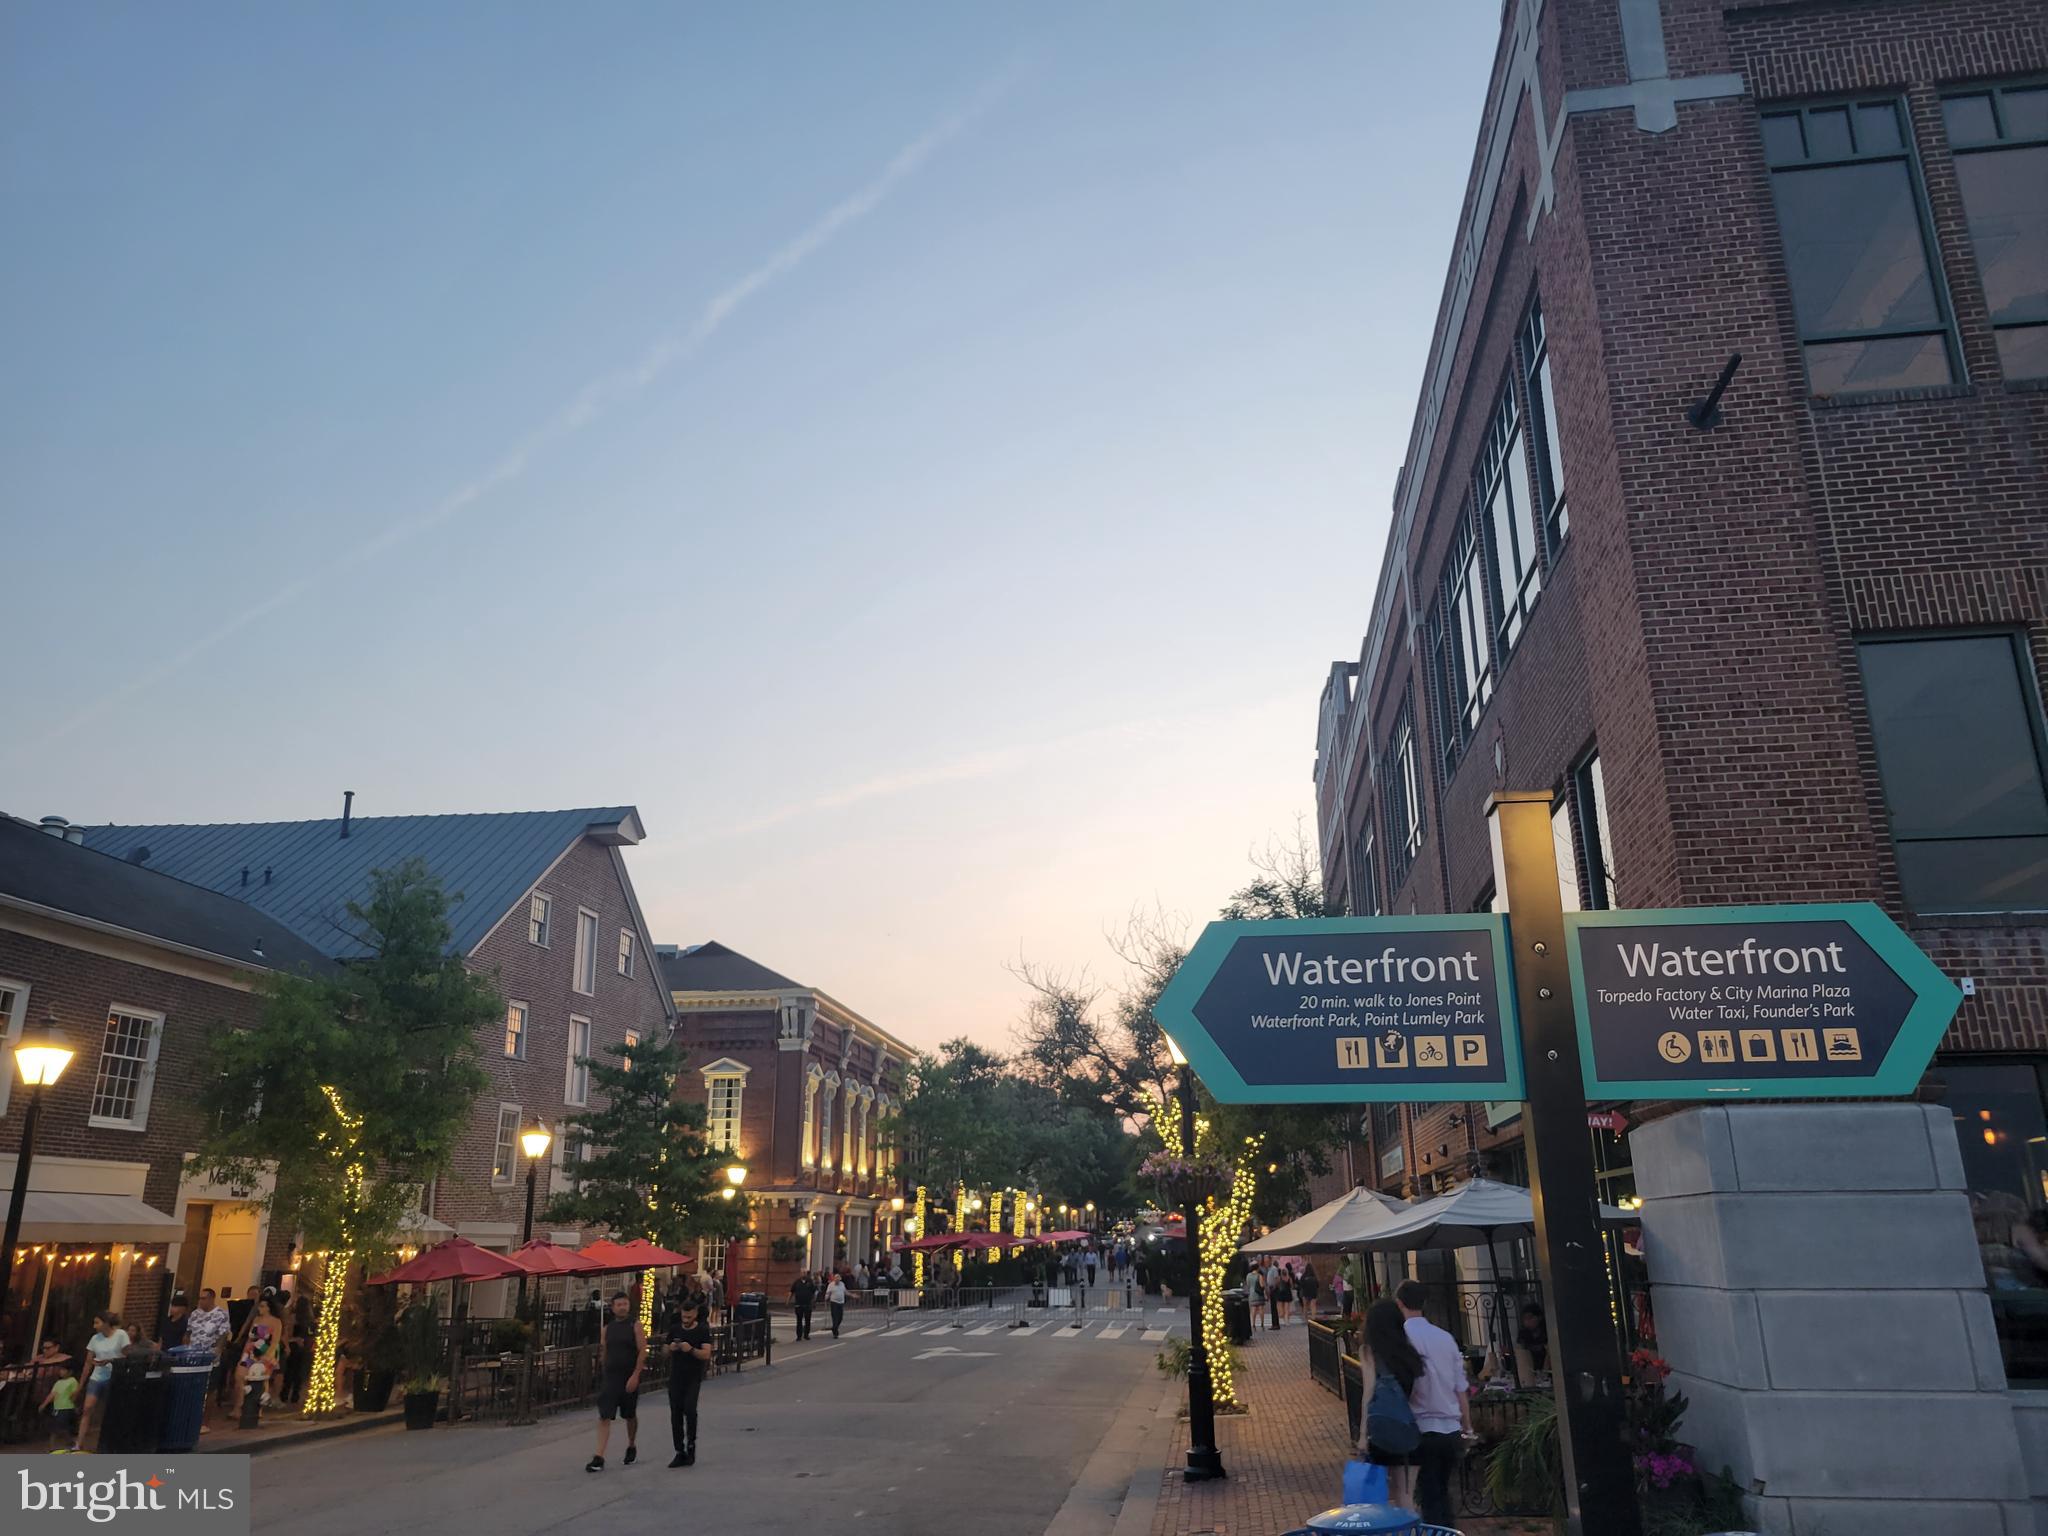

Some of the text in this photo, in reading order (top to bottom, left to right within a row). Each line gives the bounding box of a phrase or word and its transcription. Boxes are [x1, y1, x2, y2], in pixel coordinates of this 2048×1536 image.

[1263, 947, 1480, 986] Waterfront
[1617, 938, 1847, 978] Waterfront
[1300, 992, 1481, 1009] 20 min. walk to Jones Point
[1597, 983, 1850, 1005] Torpedo Factory & City Marina Plaza
[1251, 1010, 1485, 1030] Waterfront Park, Point Lumley Park
[1669, 1002, 1855, 1020] Water Taxi, Founder's Park
[1463, 1039, 1480, 1061] P
[1335, 1520, 1372, 1529] PAPER
